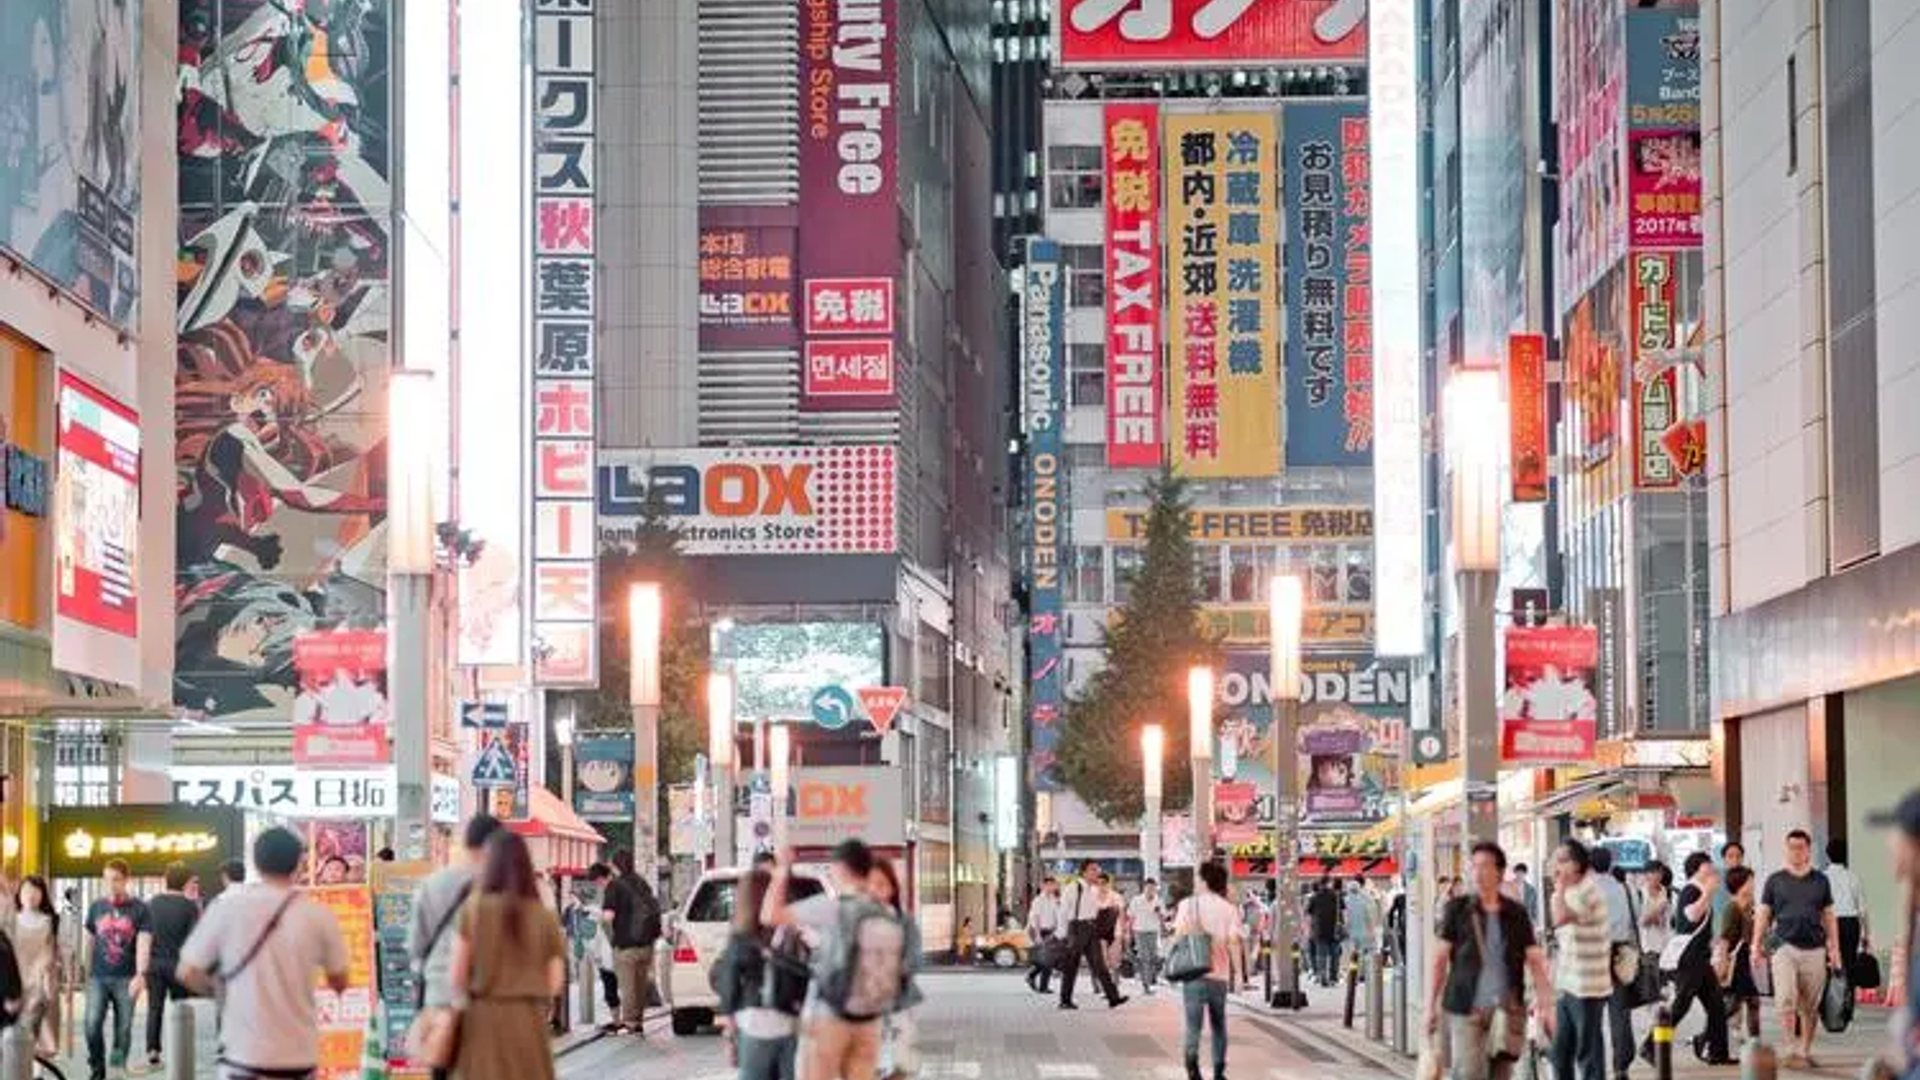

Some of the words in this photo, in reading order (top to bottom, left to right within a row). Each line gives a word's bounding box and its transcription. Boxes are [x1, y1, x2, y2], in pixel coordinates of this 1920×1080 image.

[811, 68, 833, 140] Store
[837, 83, 890, 194] Free
[1110, 119, 1150, 212] 免税
[813, 289, 886, 323] 免税
[1113, 219, 1151, 313] TAX
[1301, 142, 1335, 407] お見積り無料です
[811, 354, 887, 381] 면세점
[1028, 262, 1058, 431] Panasonic
[1113, 323, 1154, 444] FREE
[763, 522, 817, 541] Store
[1033, 453, 1057, 588] ONODEN
